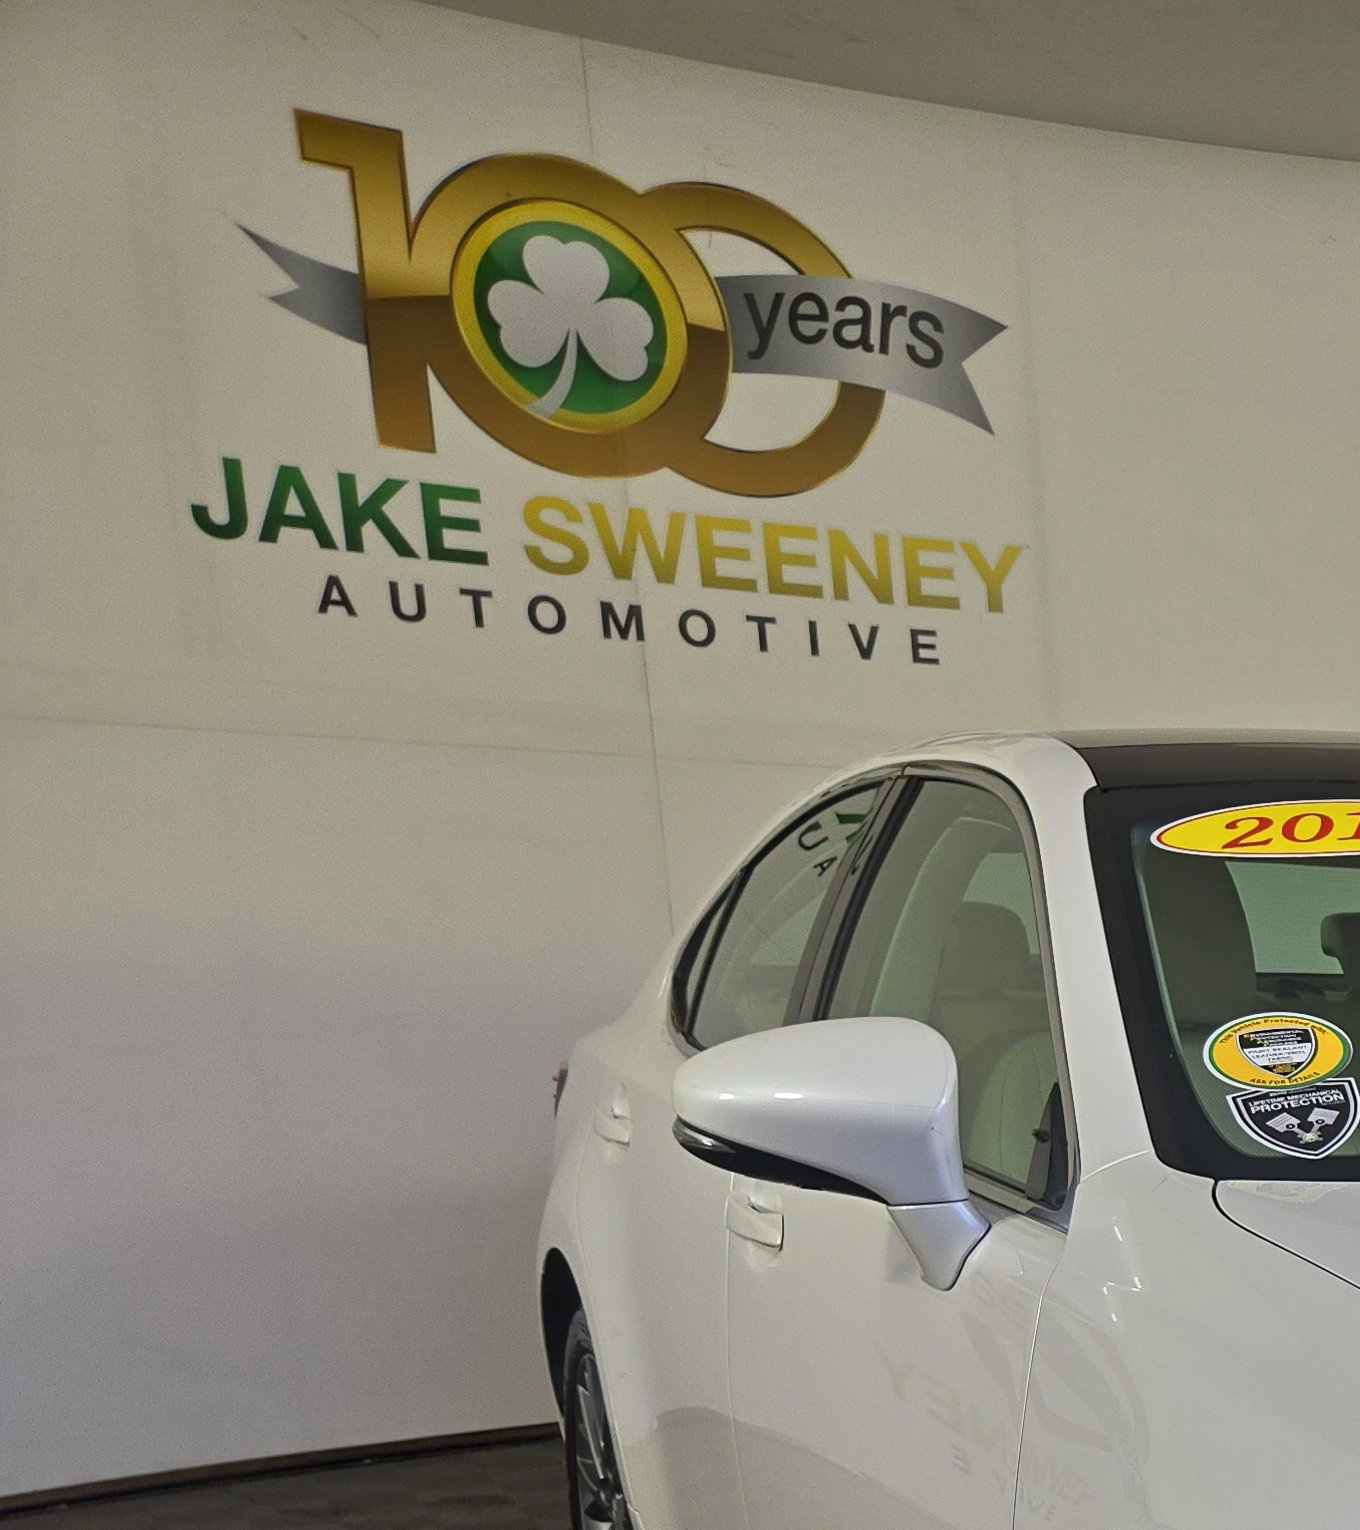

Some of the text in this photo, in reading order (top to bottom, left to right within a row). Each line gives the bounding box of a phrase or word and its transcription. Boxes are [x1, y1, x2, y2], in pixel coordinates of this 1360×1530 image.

[293, 107, 885, 497] 100
[745, 290, 947, 370] years
[190, 457, 1024, 613] JAKE SWEENEY
[317, 574, 942, 666] AUTOMOTIVE
[1250, 1093, 1345, 1114] PROTECTION
